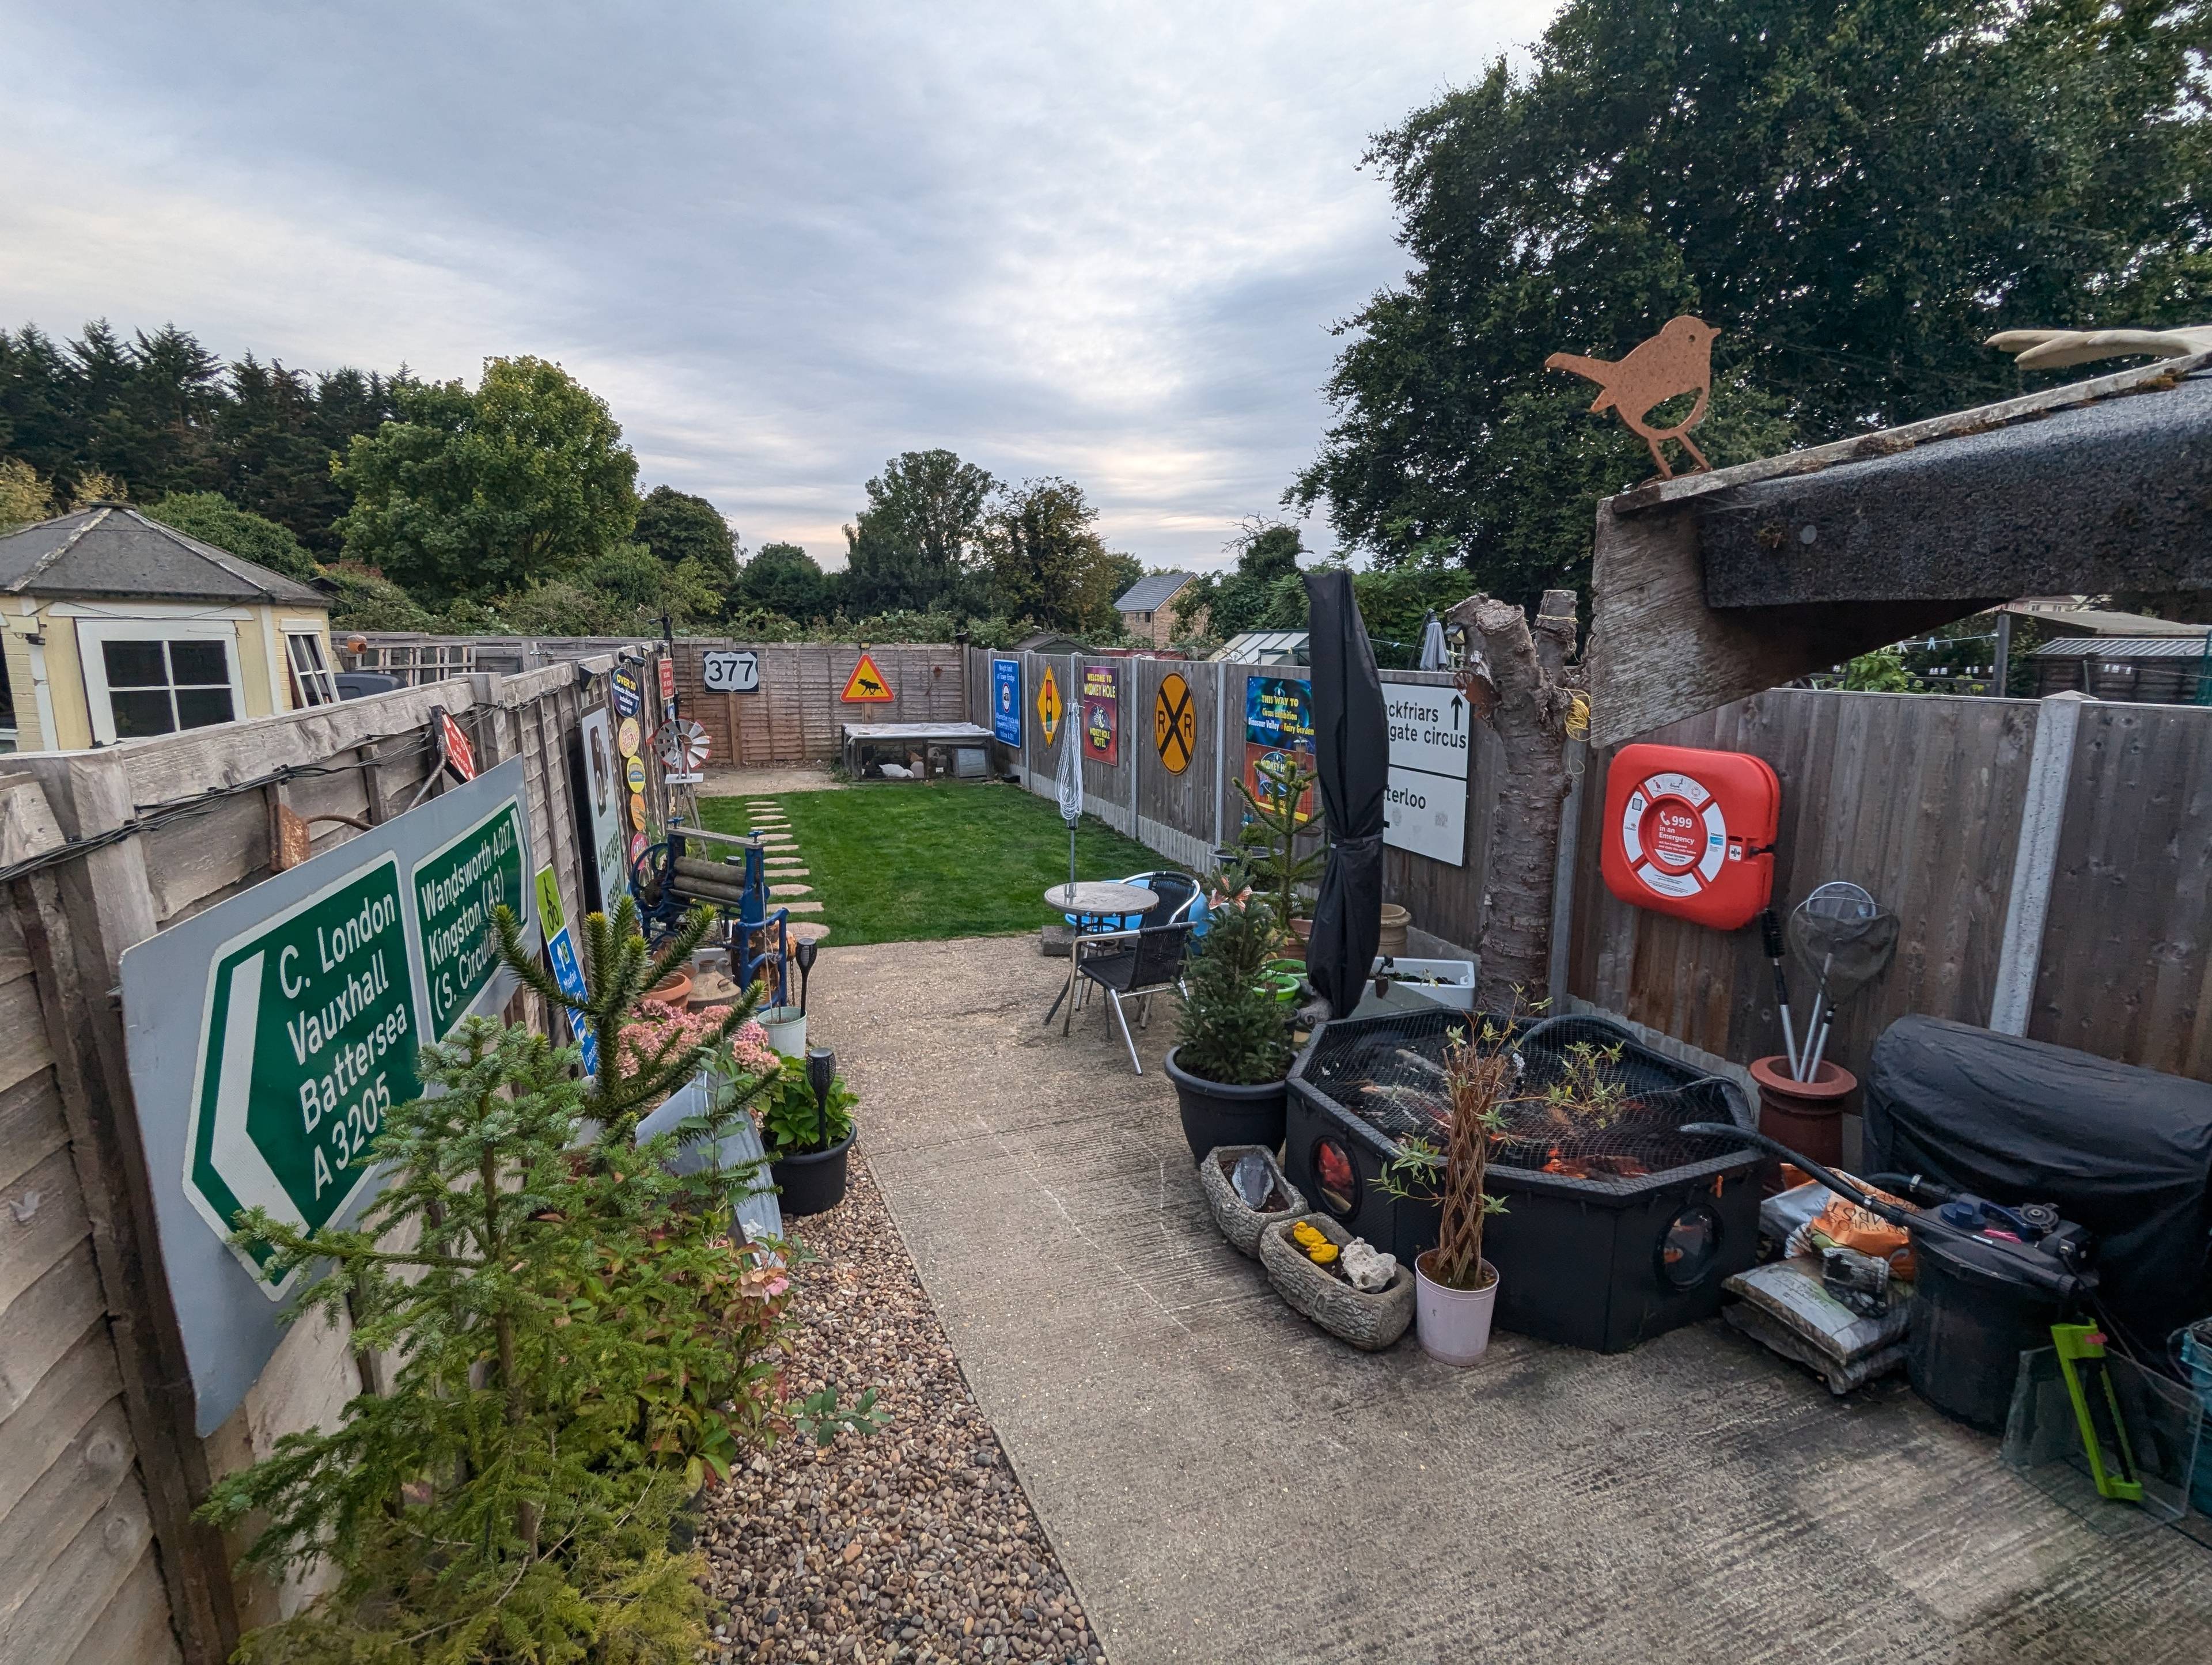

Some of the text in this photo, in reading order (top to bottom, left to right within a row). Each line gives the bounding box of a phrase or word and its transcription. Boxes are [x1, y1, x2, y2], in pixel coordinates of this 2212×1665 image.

[616, 674, 636, 691] OVER 20
[709, 660, 753, 682] 377
[1087, 673, 1112, 683] WELCOME TO
[1103, 685, 1116, 698] HOLE
[1262, 695, 1298, 707] THIS WAY TO
[1248, 716, 1314, 735] Dinosaur Valley Fairy Garden
[1389, 723, 1467, 749] gate circus
[1384, 784, 1426, 809] terloo
[1672, 816, 1692, 828] 999
[1659, 832, 1695, 845] Emergency
[600, 830, 619, 880] Average
[421, 840, 492, 921] Wandsworth
[429, 865, 504, 972] Kingston (A3)
[279, 893, 396, 1000] C. London
[563, 969, 577, 992] Mayfair
[287, 949, 389, 1065] Vauxhall
[435, 972, 457, 1022] (S.
[300, 1003, 408, 1134] Battersea
